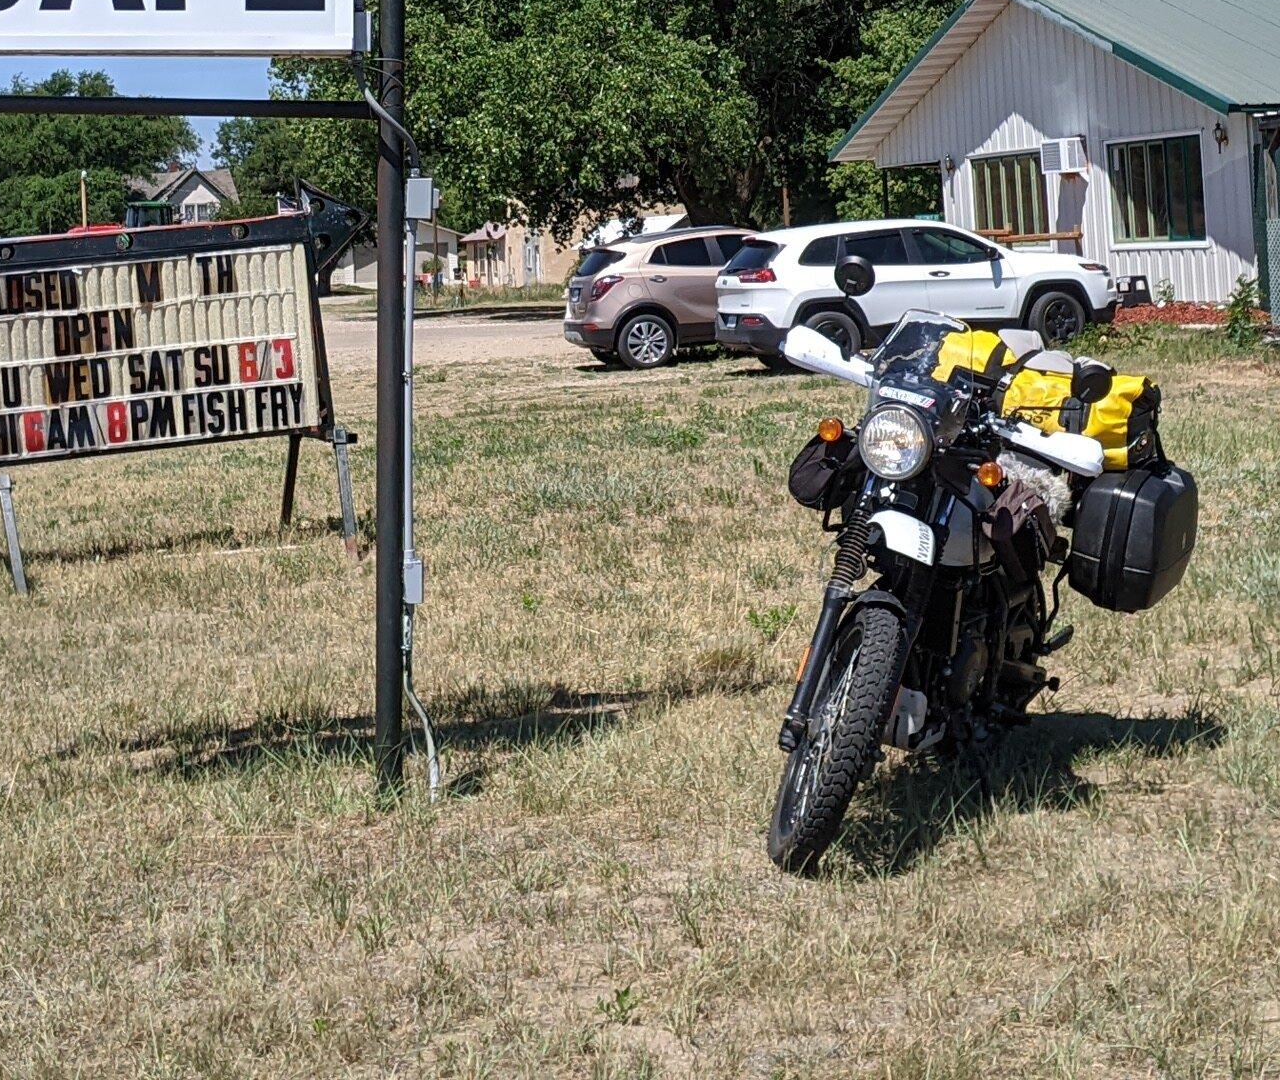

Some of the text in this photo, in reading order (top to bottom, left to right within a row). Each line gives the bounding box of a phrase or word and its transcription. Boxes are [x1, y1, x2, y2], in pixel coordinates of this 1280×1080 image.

[136, 261, 161, 302] M
[196, 253, 233, 296] TH
[53, 308, 133, 357] OPEN
[45, 357, 111, 404] WED
[128, 349, 183, 395] SAT
[194, 344, 230, 388] SU
[182, 389, 247, 435] FISH
[255, 382, 303, 430] FRY
